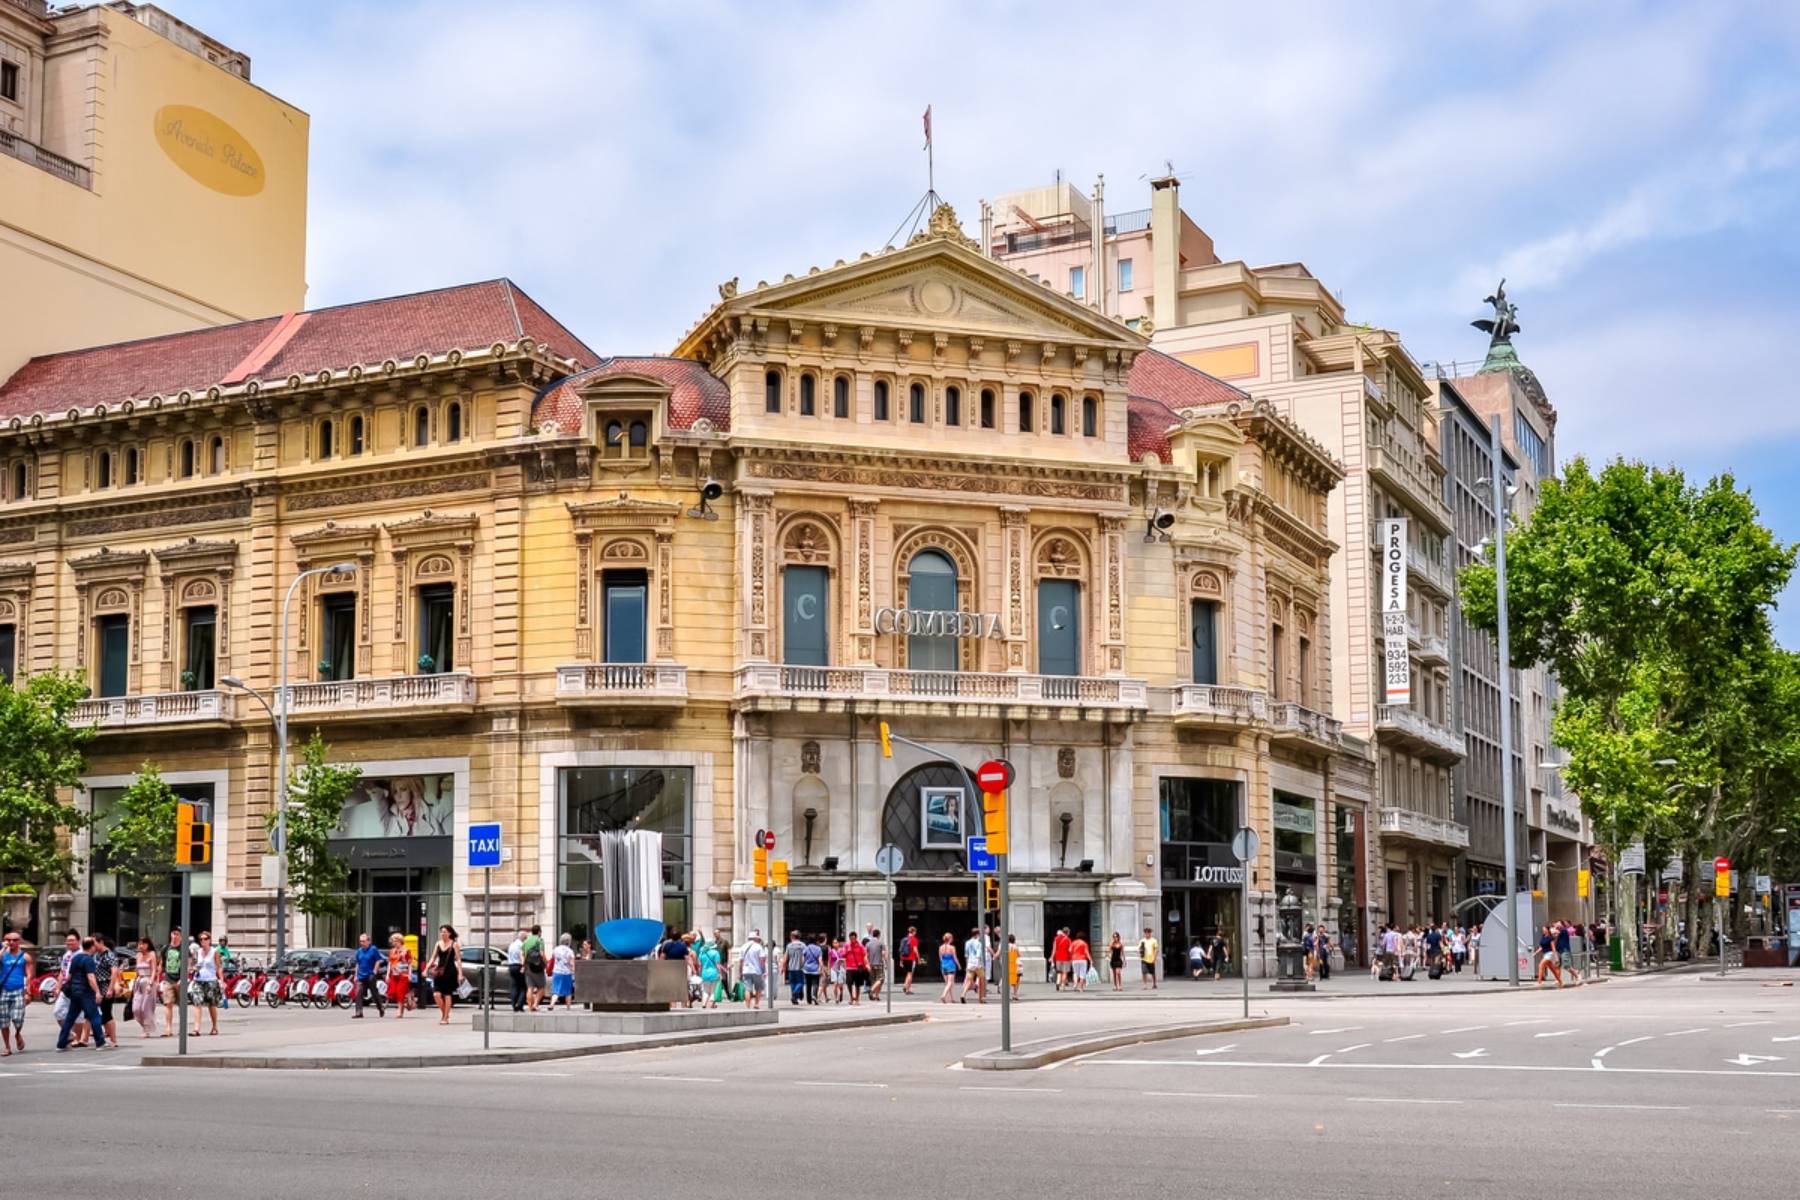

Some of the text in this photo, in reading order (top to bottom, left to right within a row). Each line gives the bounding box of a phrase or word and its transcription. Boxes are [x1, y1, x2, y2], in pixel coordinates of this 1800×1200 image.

[162, 119, 214, 158] Avenida
[1389, 524, 1401, 610] PROGESA
[875, 608, 1006, 640] COMEDIA
[1387, 650, 1407, 660] 934
[1388, 662, 1408, 672] 592
[1388, 674, 1408, 684] 233
[470, 839, 499, 853] TAXI
